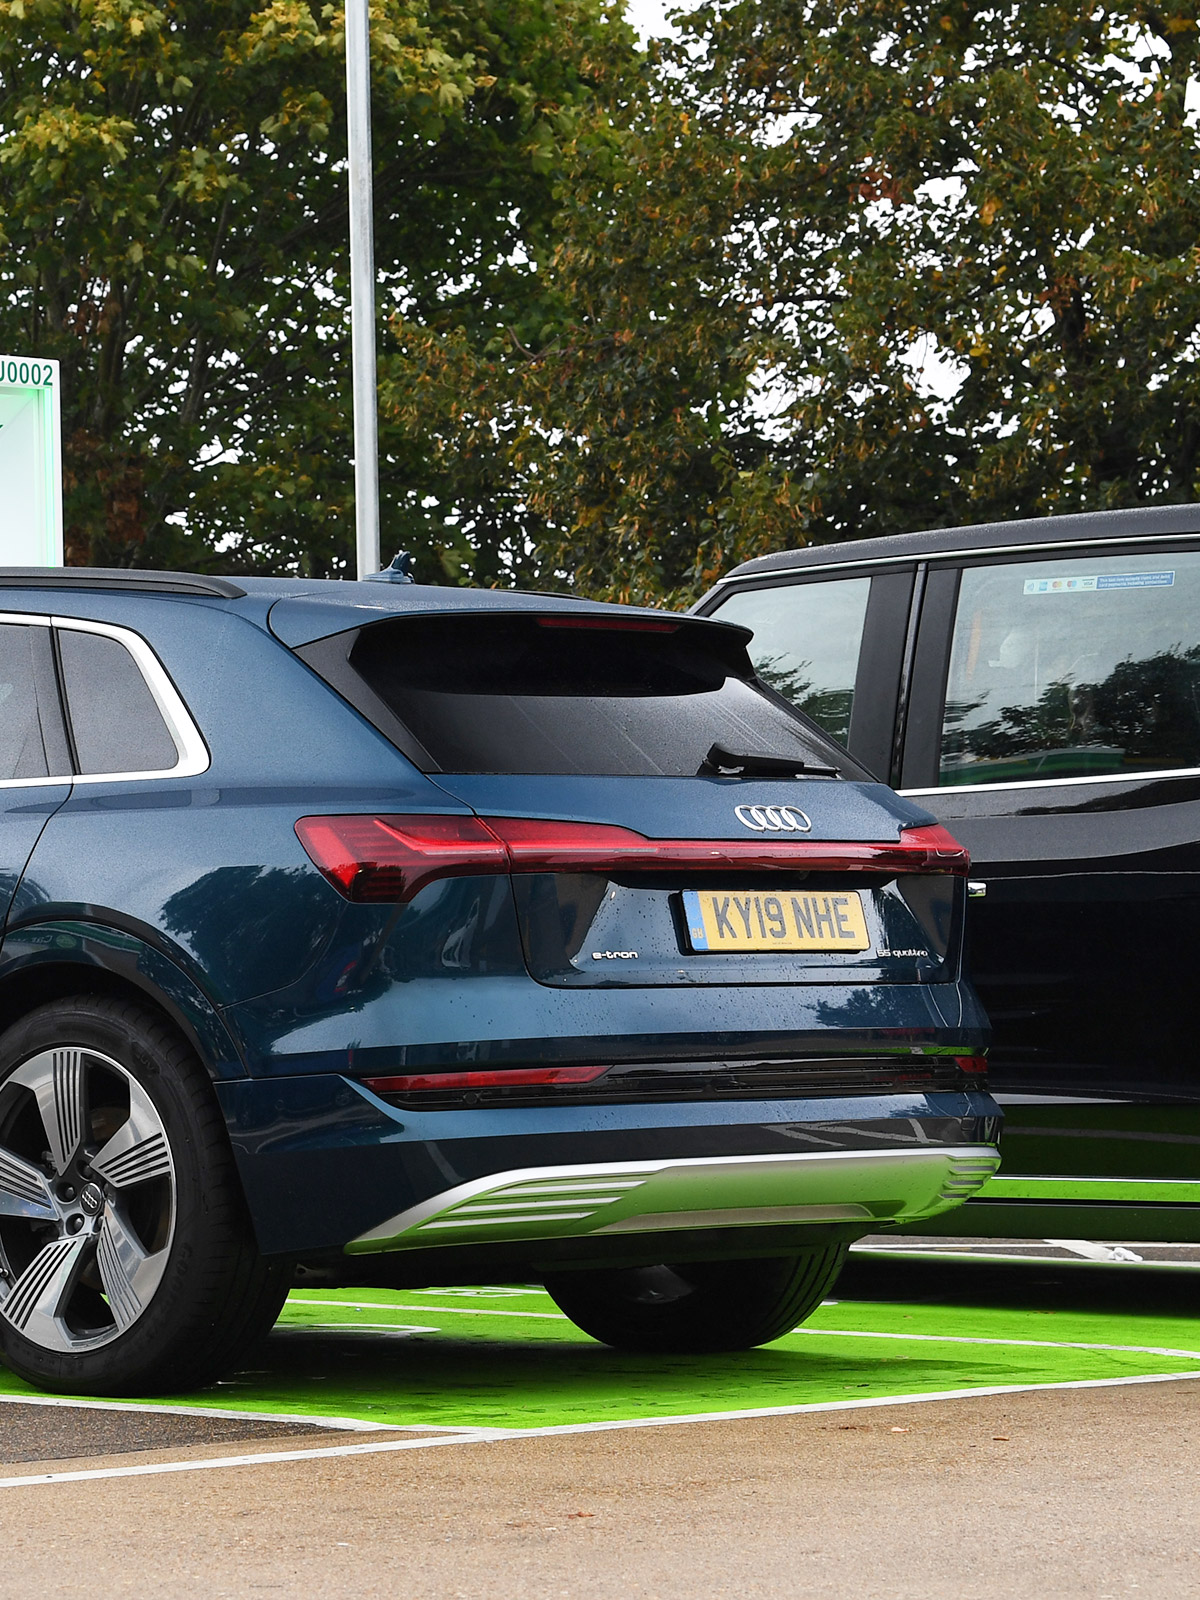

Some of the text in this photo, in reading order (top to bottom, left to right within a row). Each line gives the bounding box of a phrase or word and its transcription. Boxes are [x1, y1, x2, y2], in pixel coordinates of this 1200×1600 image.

[712, 896, 856, 939] KY19 NHE
[592, 950, 638, 960] e-tron
[877, 948, 928, 958] 55 quattro
